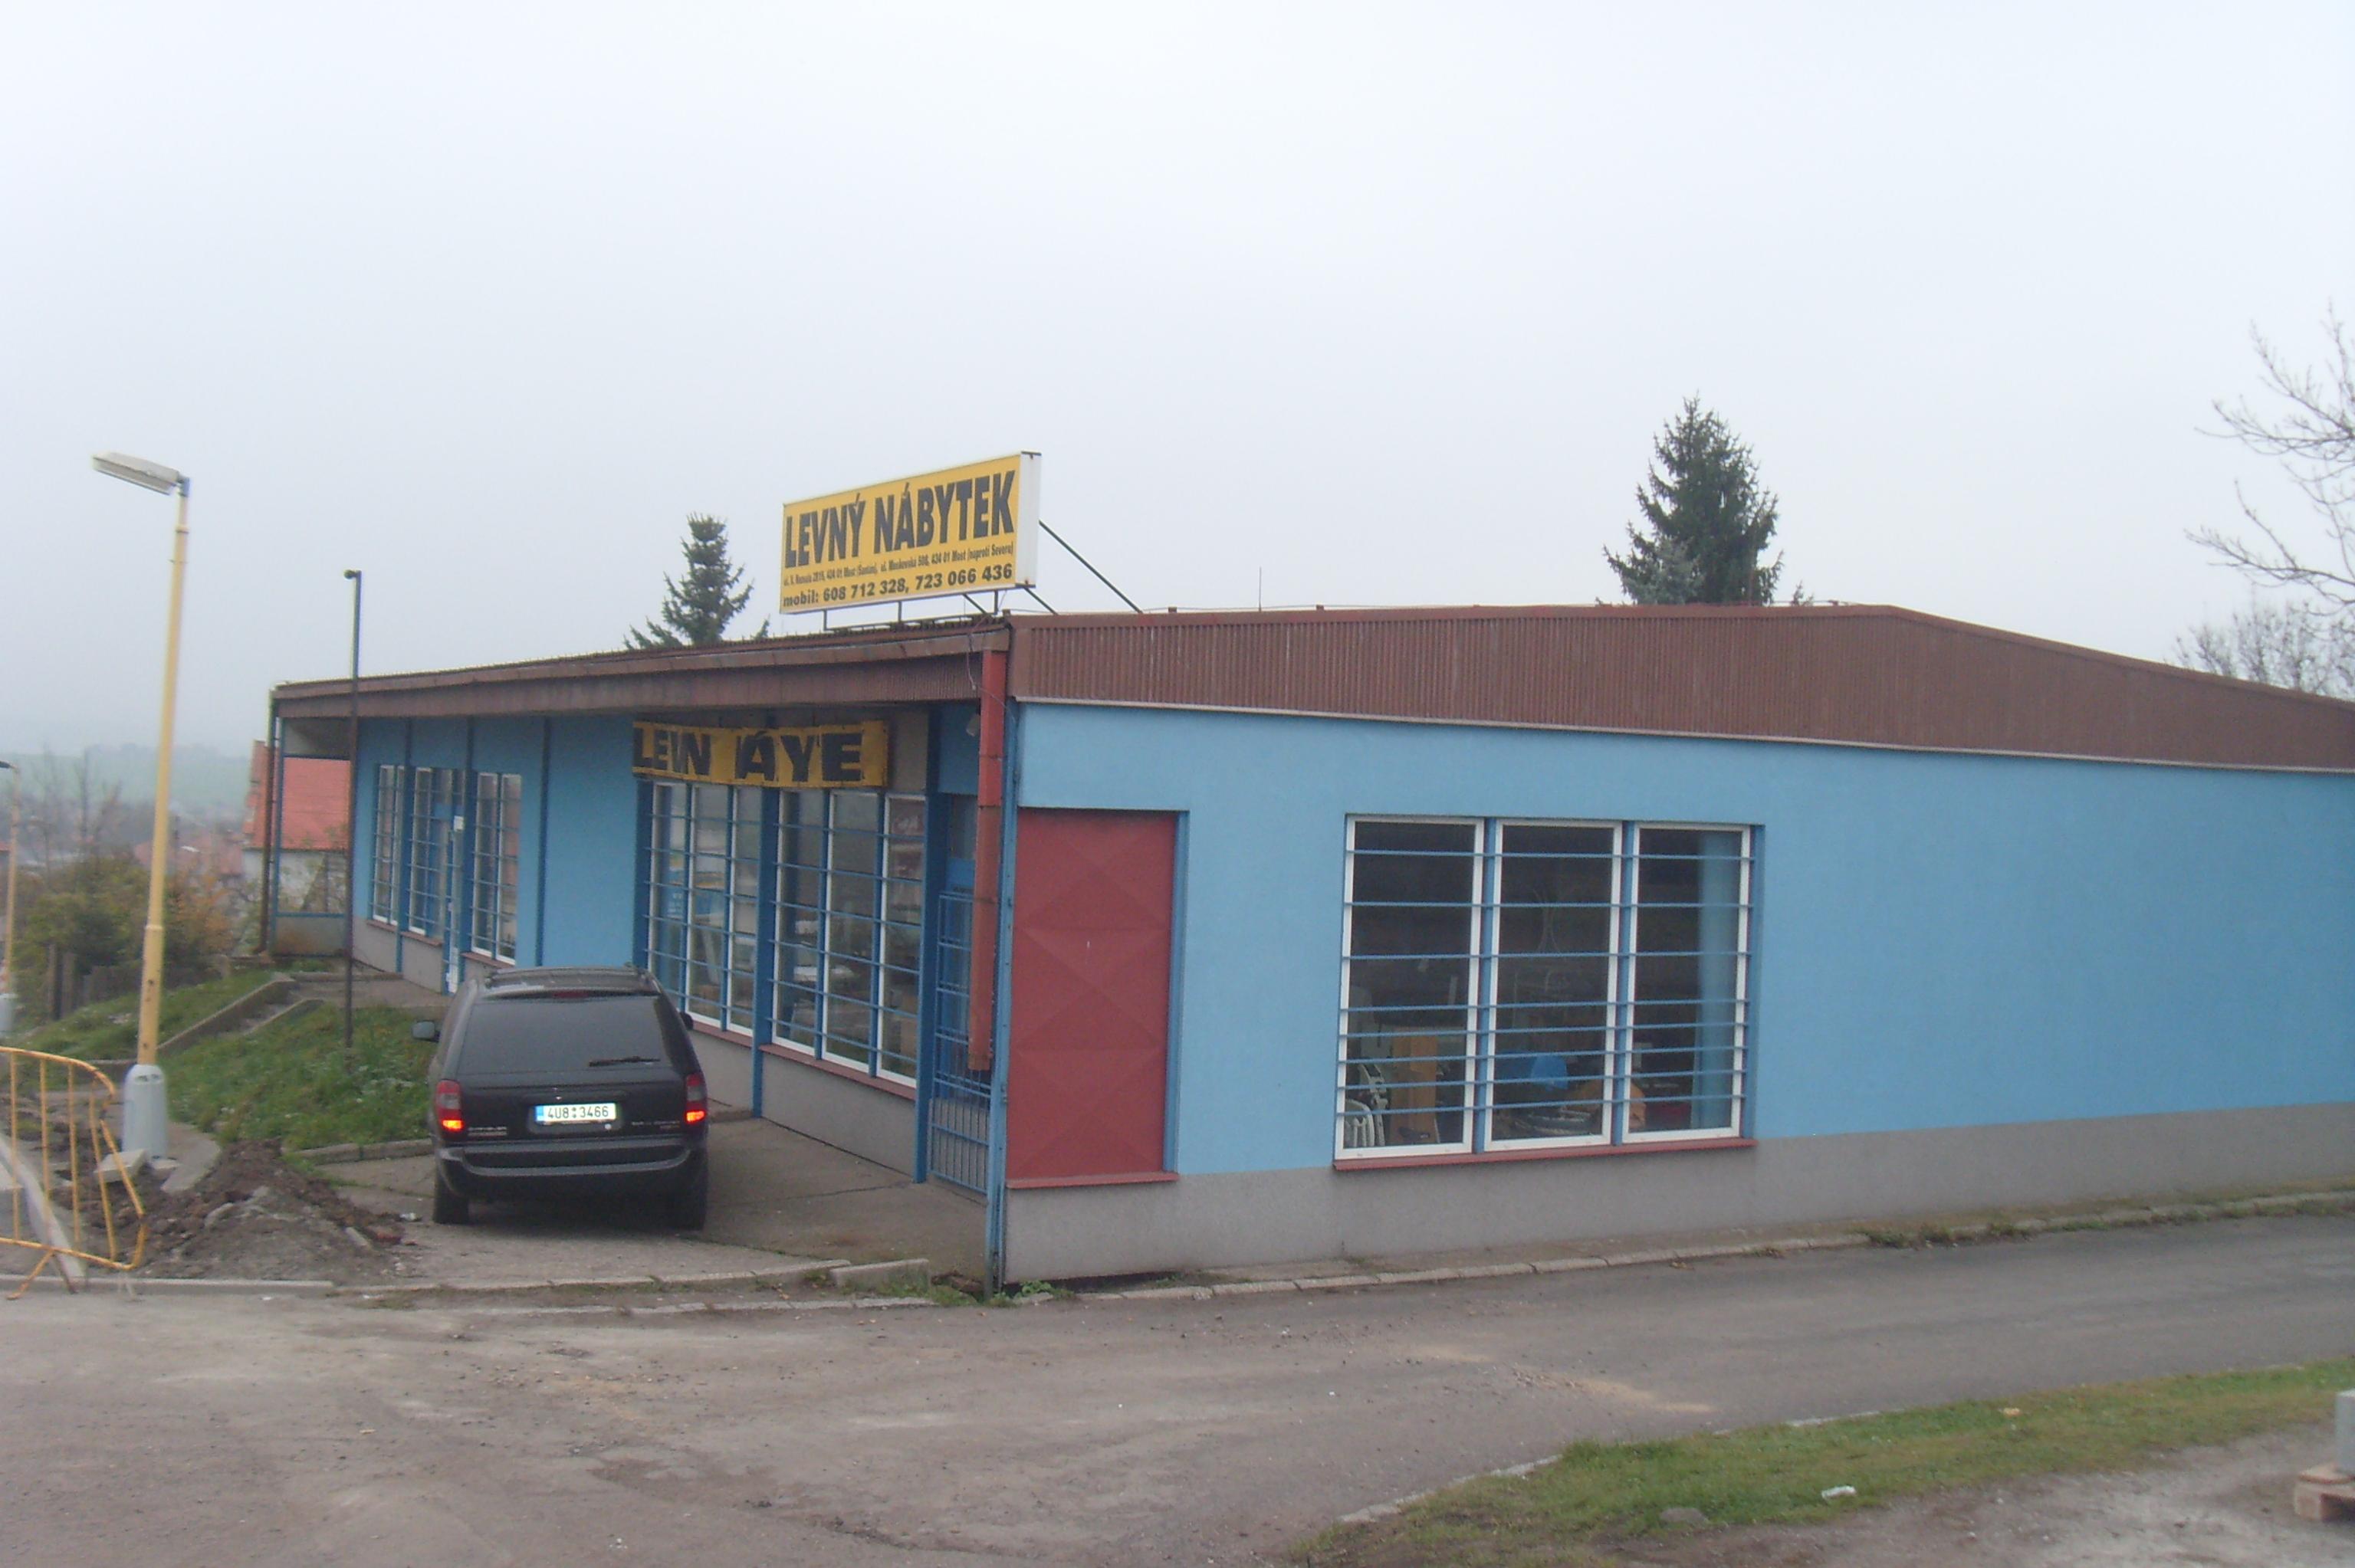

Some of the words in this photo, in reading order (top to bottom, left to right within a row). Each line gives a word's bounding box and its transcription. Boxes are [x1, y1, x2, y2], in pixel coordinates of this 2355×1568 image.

[784, 493, 866, 569] LEVNÝ
[874, 470, 1015, 554] NÁBYTEK
[783, 589, 819, 607] mobil:
[823, 586, 846, 602] 608
[851, 582, 875, 599] 712
[879, 577, 909, 595] 328,
[915, 572, 942, 590] 723
[948, 568, 977, 586] 066
[982, 563, 1013, 581] 436
[547, 1107, 569, 1119] 4U8
[579, 1105, 609, 1118] 3466
